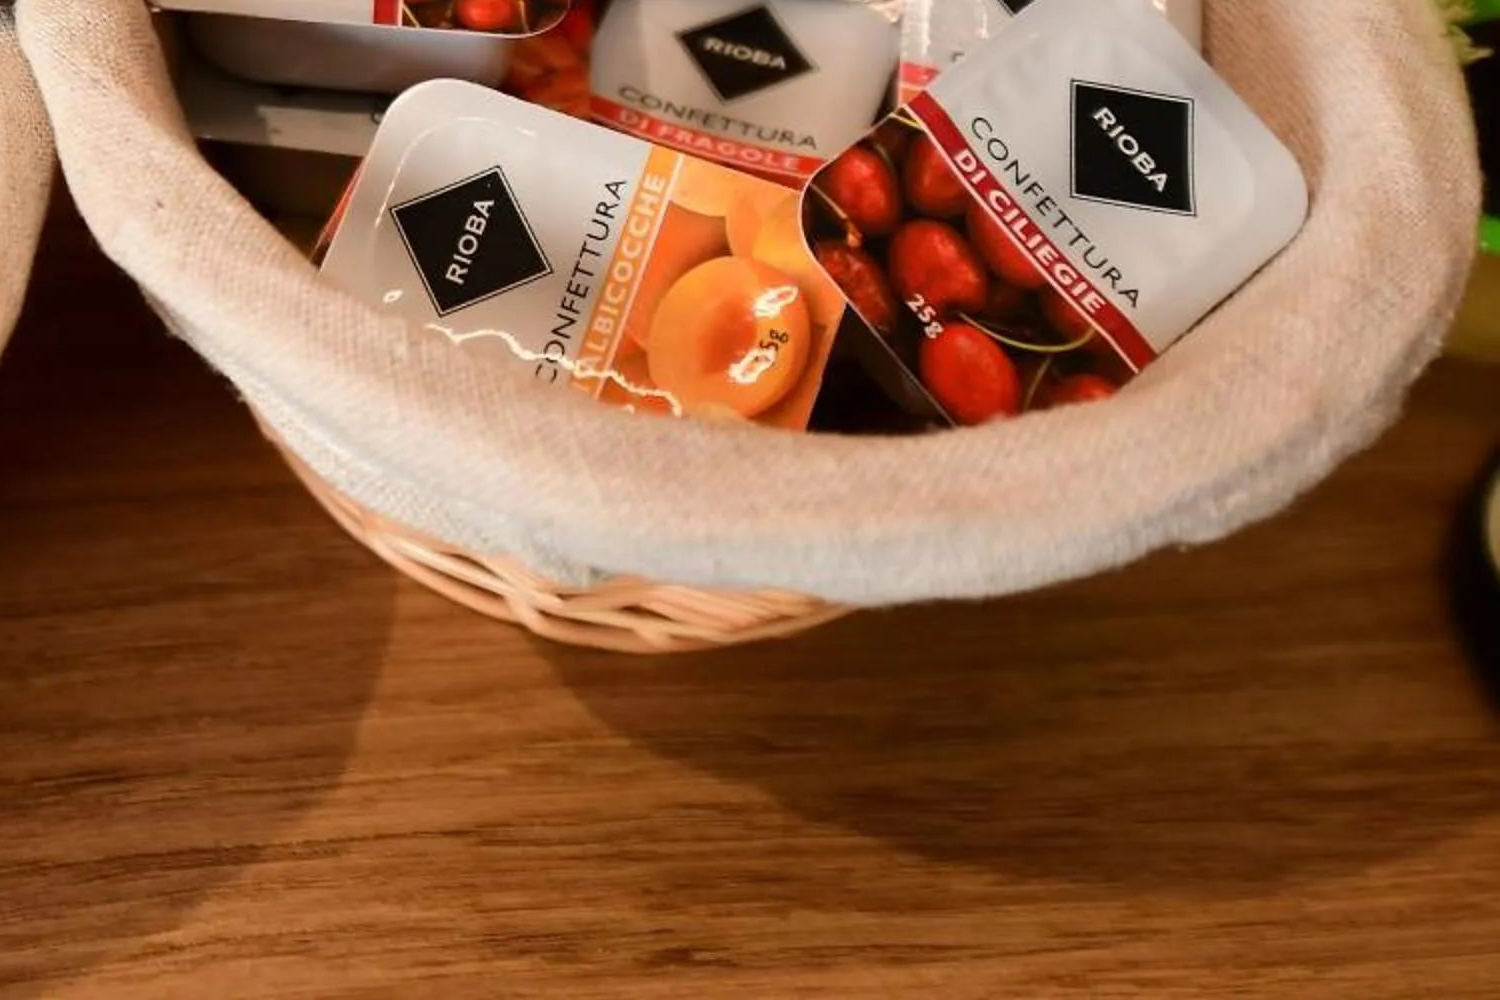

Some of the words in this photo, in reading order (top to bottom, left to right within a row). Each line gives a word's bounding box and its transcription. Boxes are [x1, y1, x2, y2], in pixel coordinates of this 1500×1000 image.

[702, 35, 788, 70] RIOBA
[616, 83, 819, 150] CONFETTURA
[617, 107, 646, 129] DI
[667, 119, 803, 172] FRAGOLE
[1093, 107, 1171, 193] RIOBA
[444, 197, 496, 286] RIOBA
[953, 148, 988, 188] DI
[990, 187, 1107, 317] CILIEGIE
[970, 115, 1141, 309] CONFETTURA
[904, 294, 946, 339] 25g
